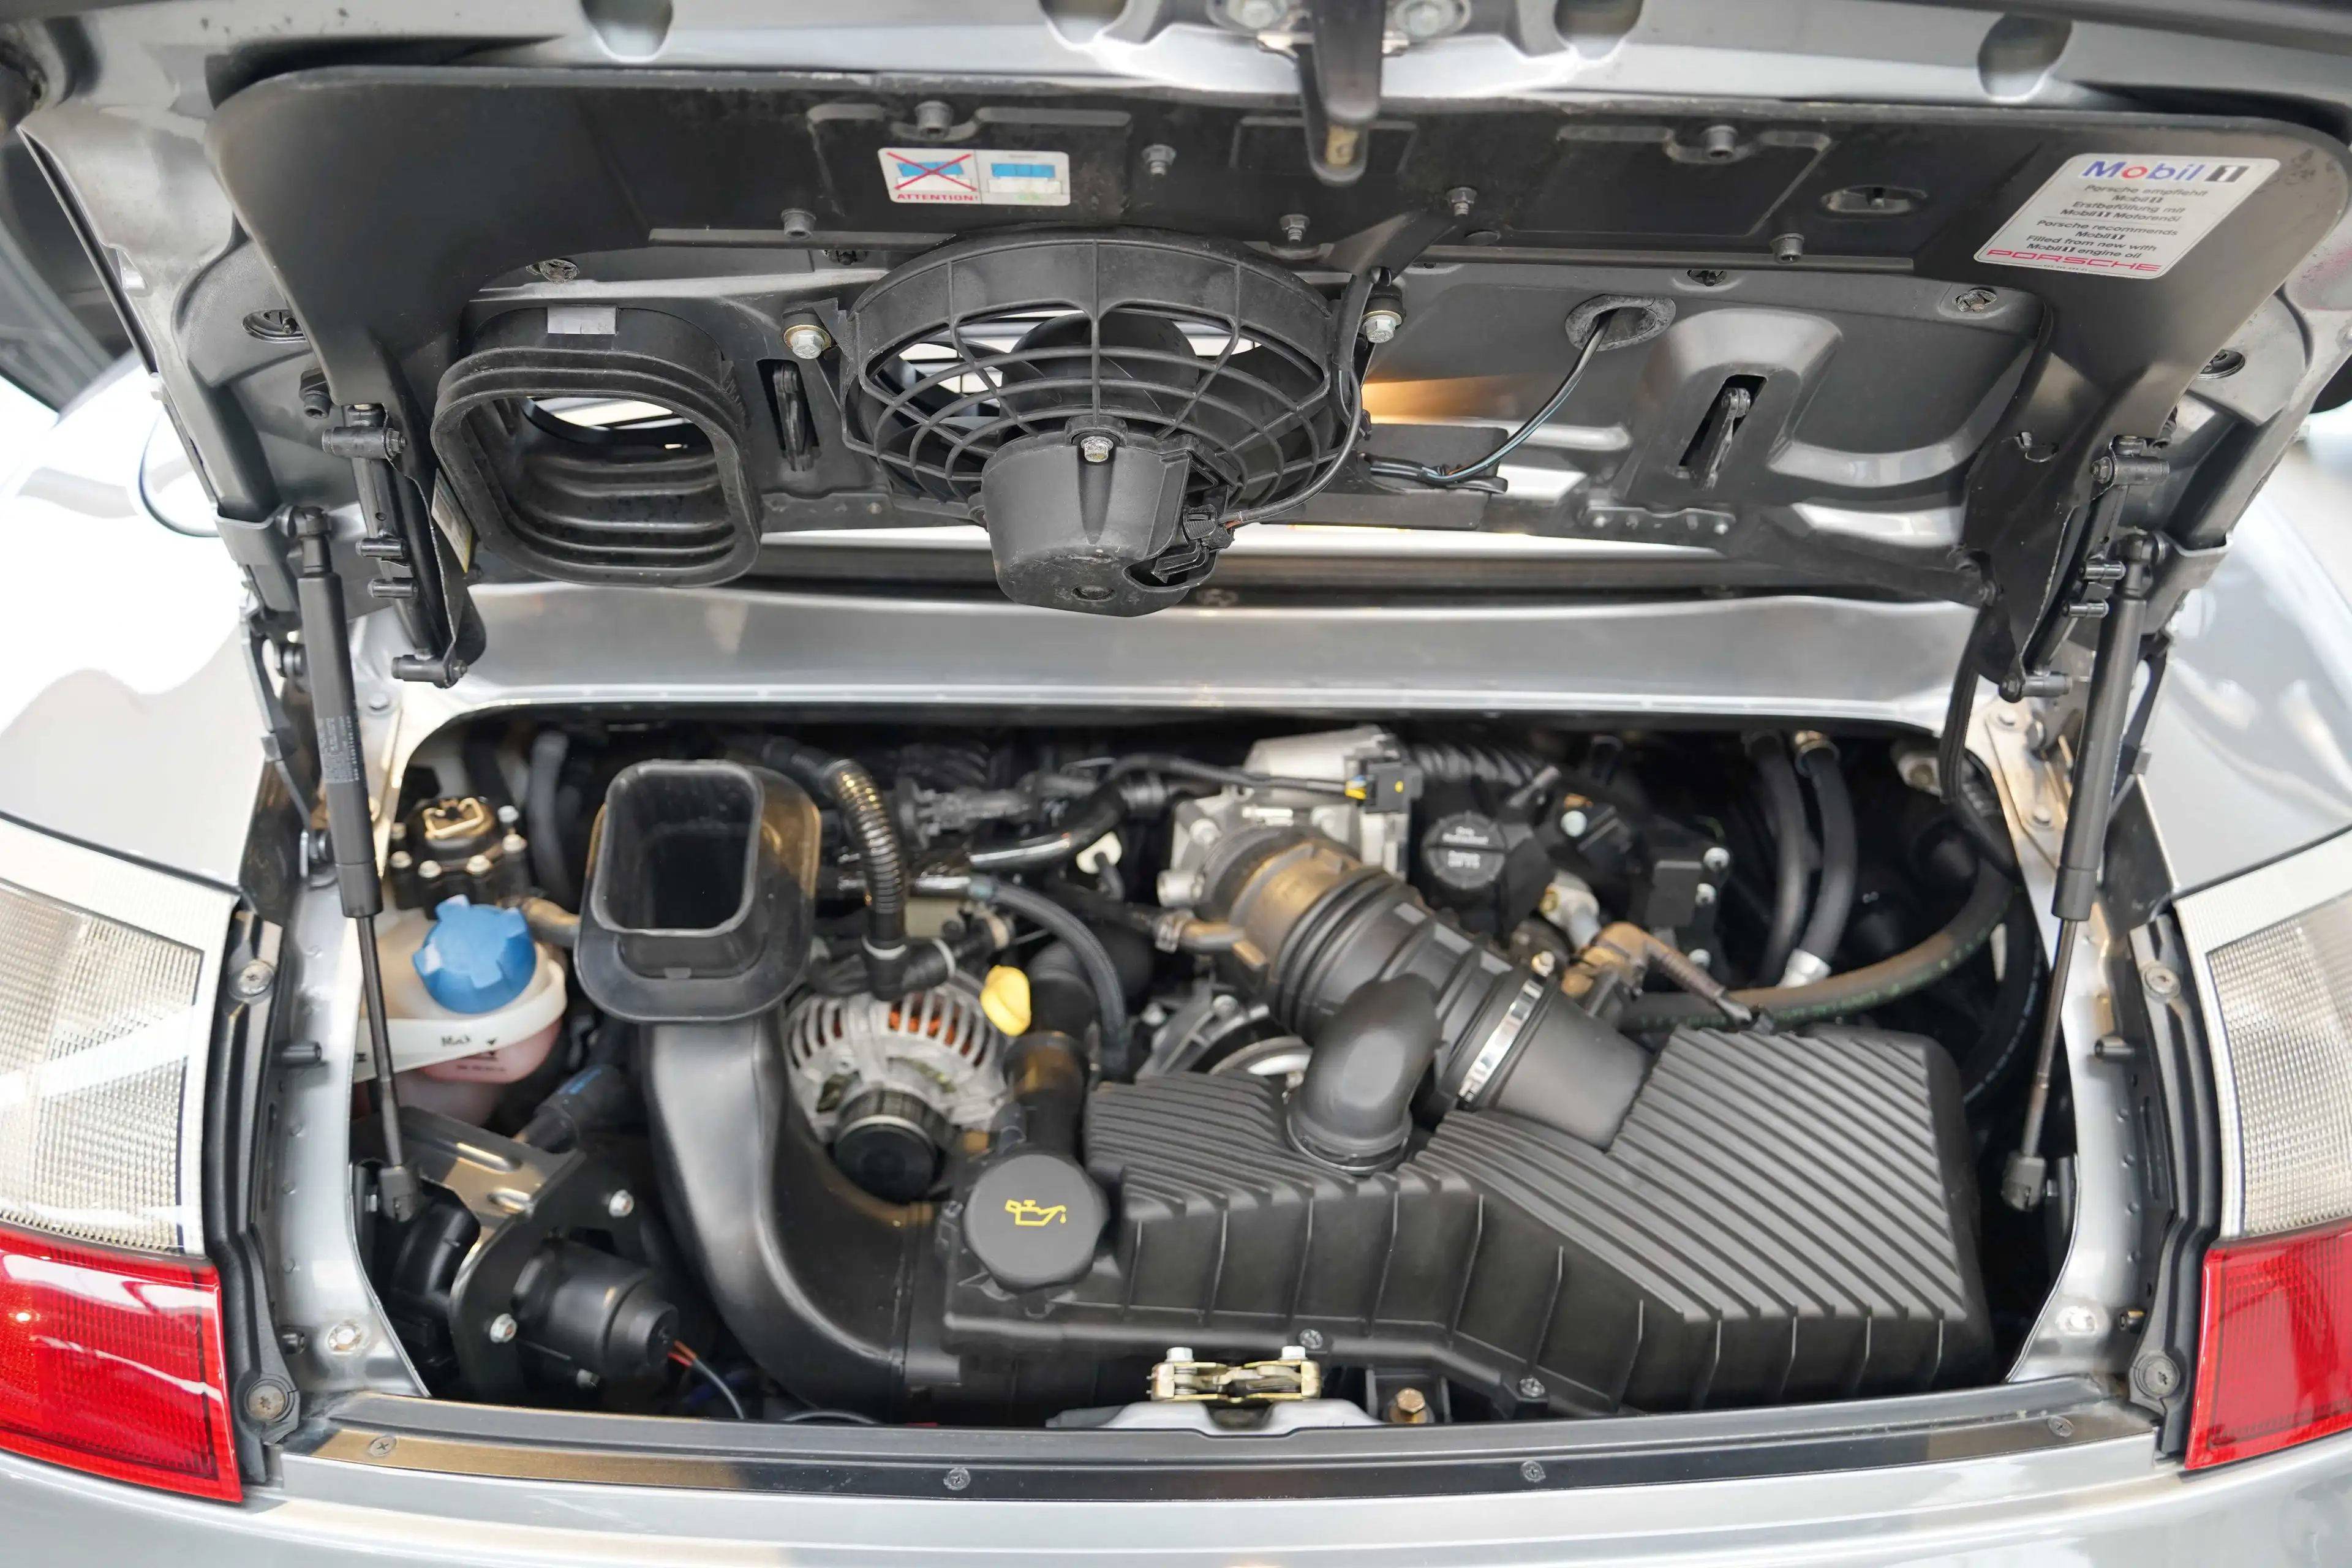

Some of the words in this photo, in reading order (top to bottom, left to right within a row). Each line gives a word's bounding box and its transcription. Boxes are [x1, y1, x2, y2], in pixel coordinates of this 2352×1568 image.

[2082, 160, 2205, 181] Mobil
[2204, 165, 2250, 183] 1
[2084, 184, 2139, 194] Porsche
[2071, 201, 2160, 213] Erstbefüllung
[2113, 213, 2182, 222] Motorenöl
[2036, 219, 2089, 229] Porsche
[2092, 224, 2179, 236] recommends
[2075, 231, 2113, 239] Mobil
[2026, 235, 2064, 244] Filled
[2130, 243, 2158, 252] with
[2026, 243, 2064, 252] Mobil
[2077, 248, 2122, 257] engine
[1986, 249, 2162, 271] PORSCHE
